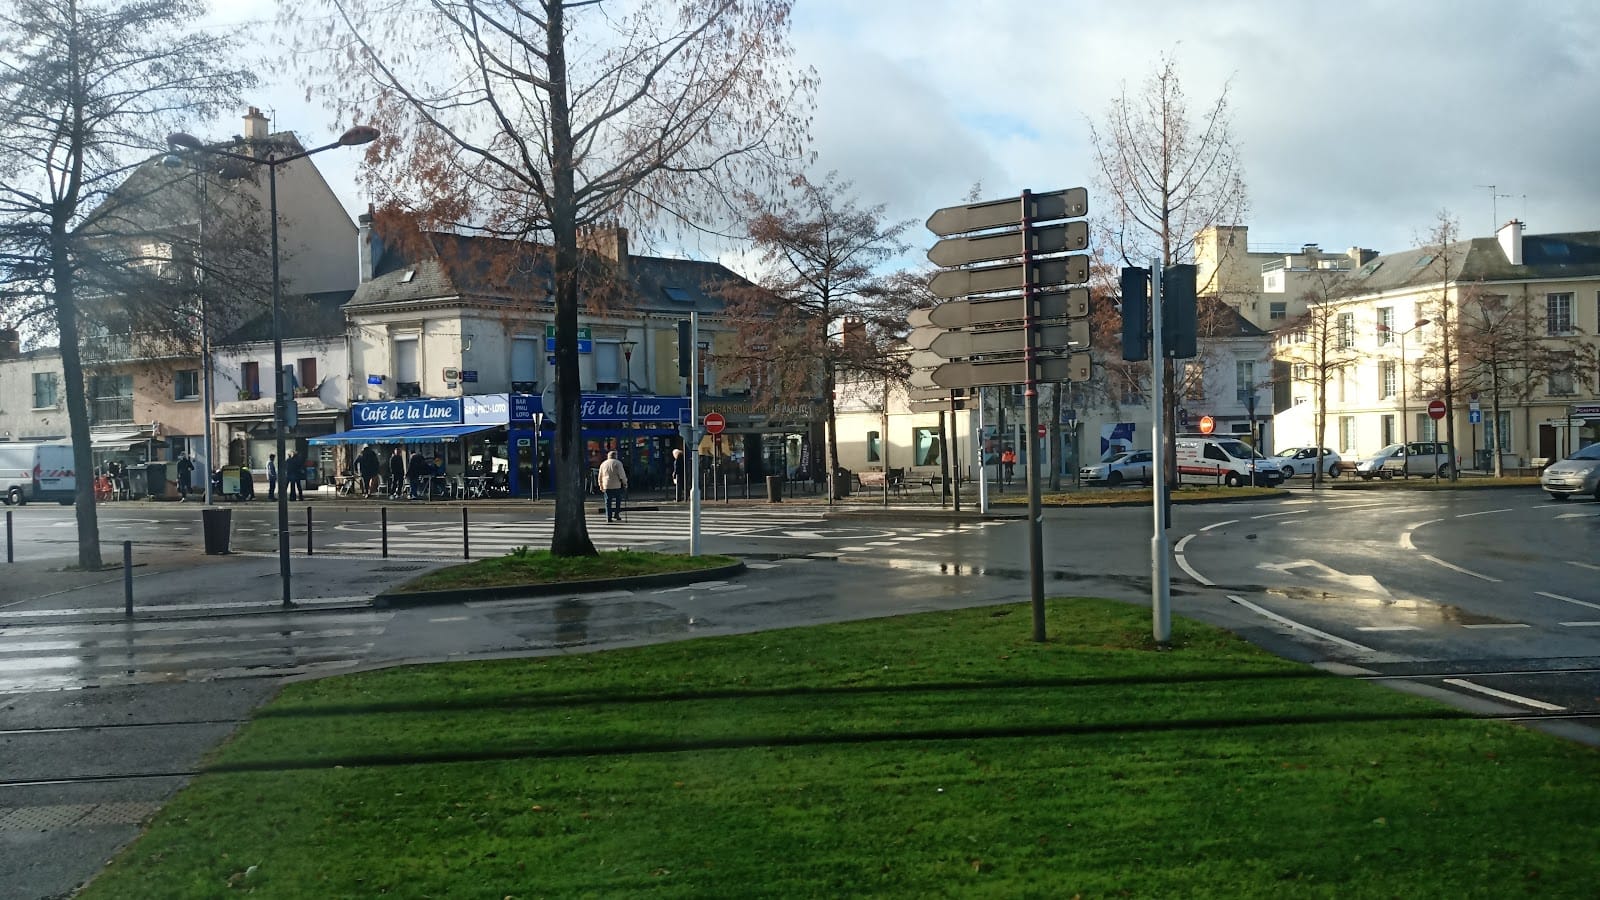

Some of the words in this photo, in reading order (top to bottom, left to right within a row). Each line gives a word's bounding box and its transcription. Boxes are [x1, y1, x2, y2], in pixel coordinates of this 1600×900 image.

[361, 406, 388, 422] Café
[390, 405, 405, 420] de
[407, 404, 420, 419] la
[423, 403, 452, 419] Lune
[580, 400, 596, 417] fé
[598, 401, 613, 415] de
[616, 401, 629, 415] la
[632, 401, 661, 415] Lune
